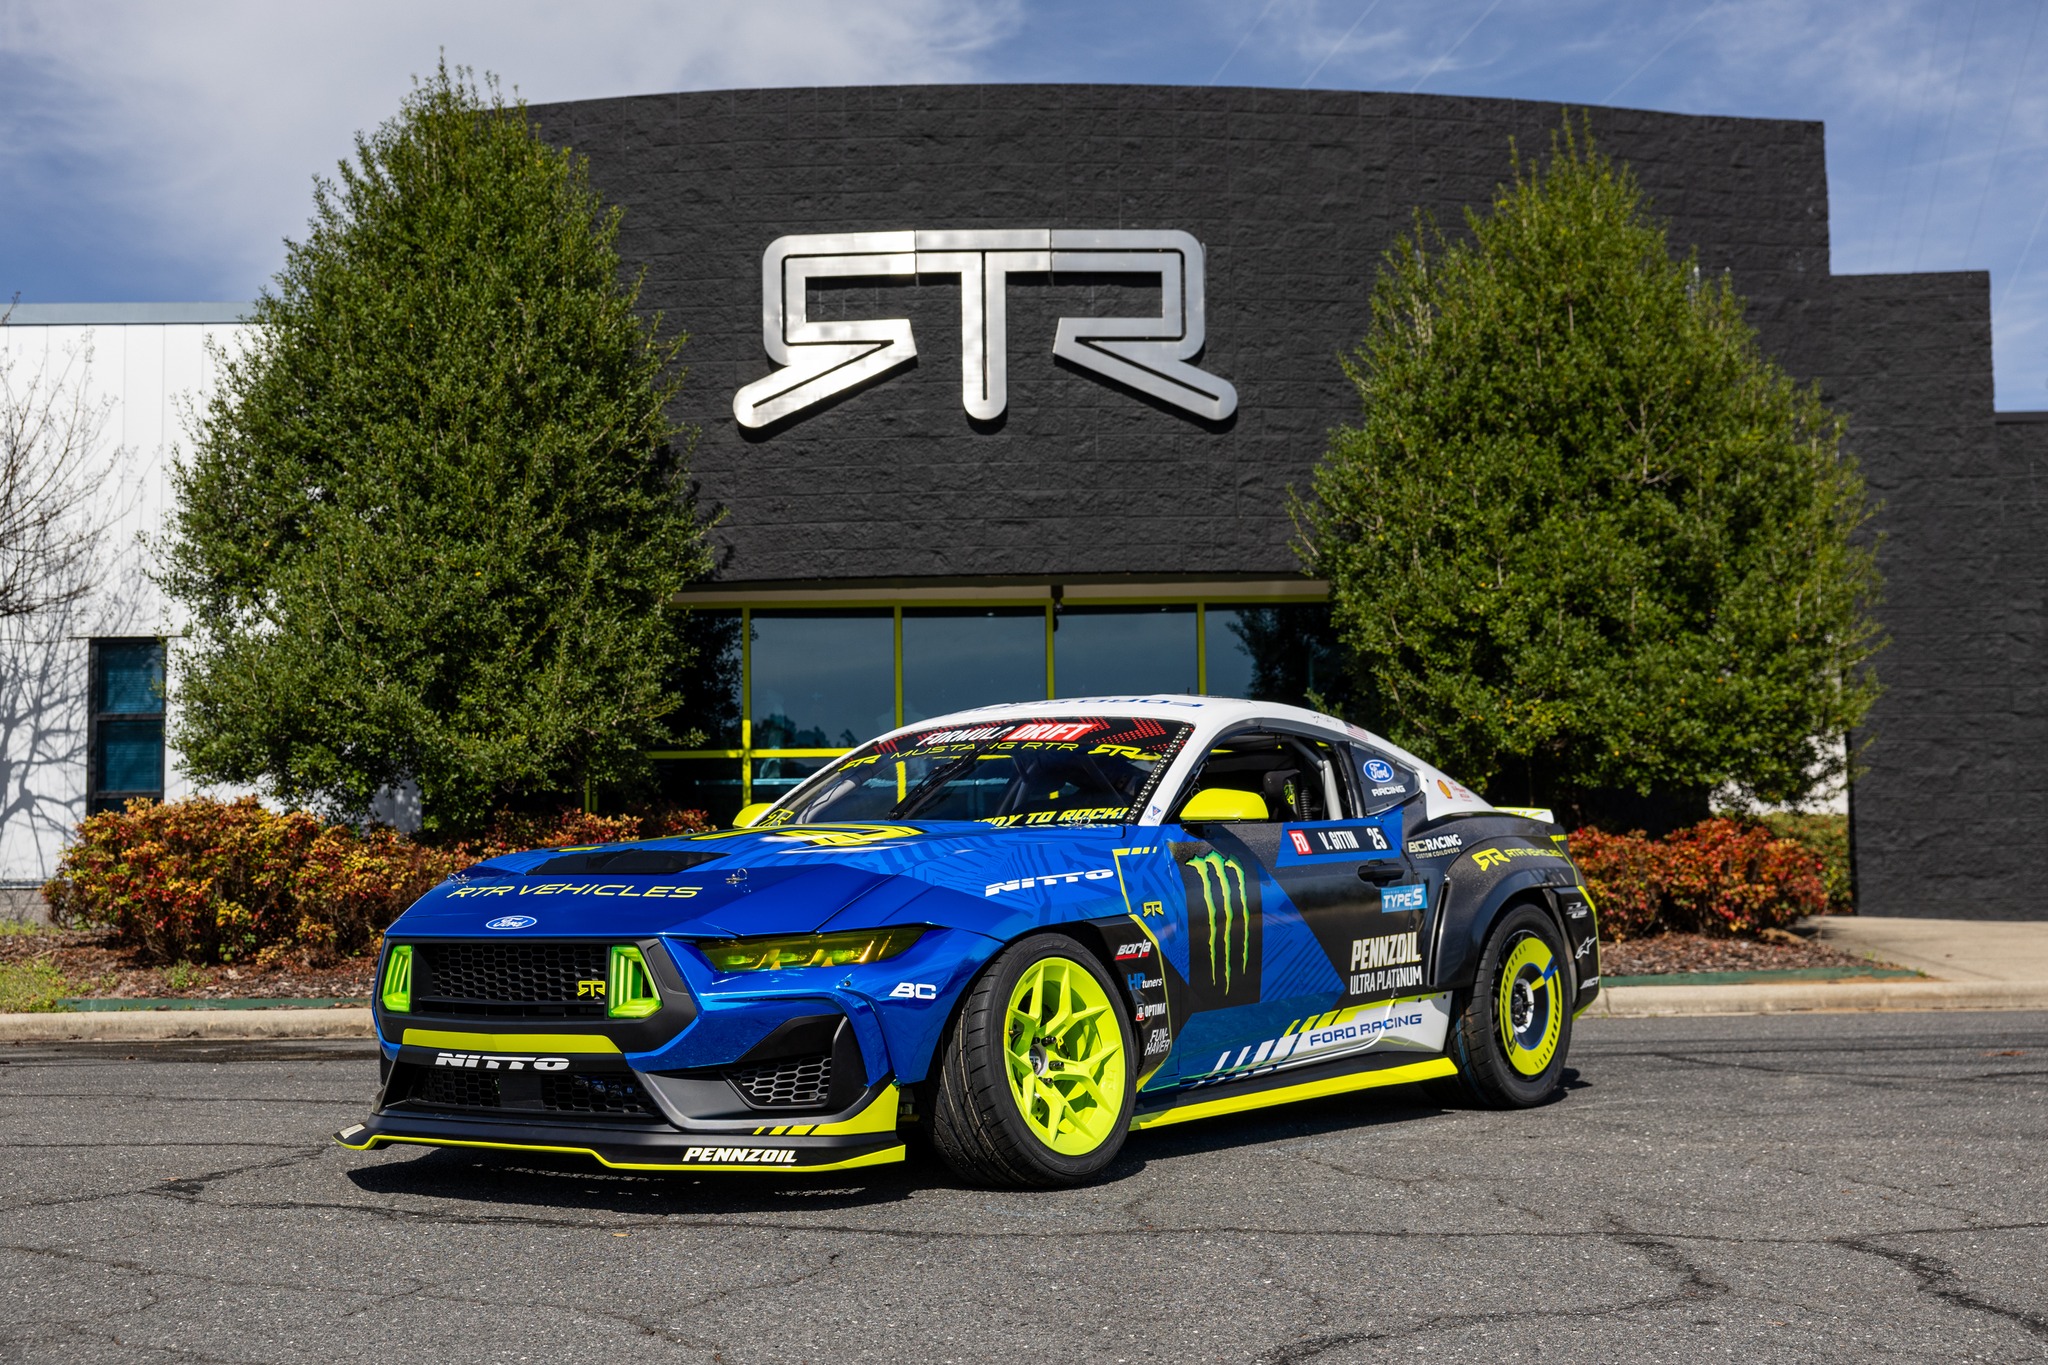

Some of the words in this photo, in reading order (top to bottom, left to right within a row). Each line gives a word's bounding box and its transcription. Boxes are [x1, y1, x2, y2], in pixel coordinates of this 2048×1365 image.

[733, 229, 1238, 428] RTR
[1007, 723, 1093, 741] DRIFT
[1020, 742, 1079, 751] RTR
[1367, 762, 1391, 780] Ford
[1371, 785, 1406, 797] RACING
[1025, 811, 1057, 824] TO
[1059, 807, 1130, 822] ROCK!
[1291, 833, 1310, 852] FD
[1366, 827, 1388, 850] 25
[1415, 852, 1433, 860] CUSTOM
[1471, 848, 1511, 872] RTR
[446, 885, 516, 899] RTR
[518, 883, 703, 898] VEHICLES
[985, 868, 1114, 897] NITTO
[1142, 901, 1164, 917] RTR
[490, 916, 531, 928] Ford
[1350, 931, 1422, 972] PENNZOIL
[577, 980, 605, 997] RTR
[1350, 972, 1376, 996] ULTRA
[1376, 965, 1423, 992] PLATINUM
[889, 982, 936, 999] BC
[1145, 1003, 1166, 1018] OPTIMA
[1150, 1027, 1168, 1043] FUN-
[1310, 1026, 1356, 1046] FORD
[1360, 1014, 1423, 1036] RACING
[1144, 1039, 1171, 1056] HAVER
[434, 1052, 570, 1071] NITTO
[682, 1147, 798, 1163] PENNZOIL
